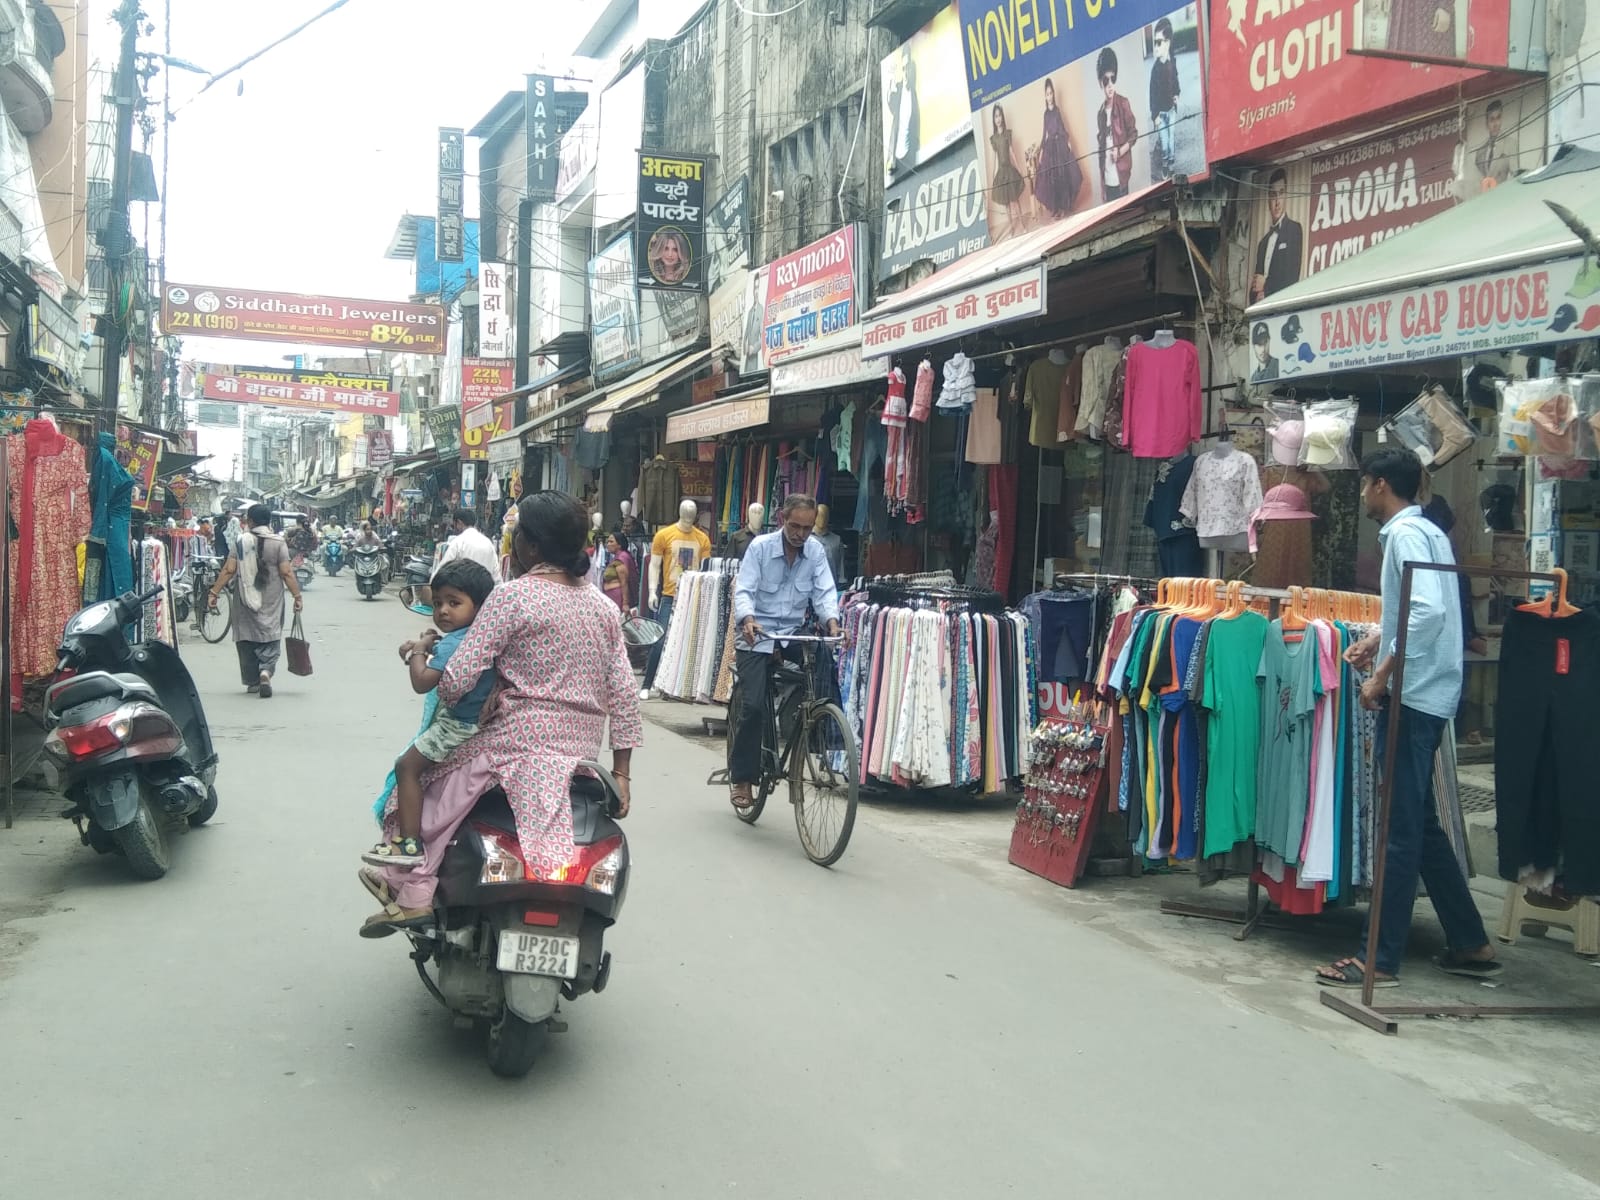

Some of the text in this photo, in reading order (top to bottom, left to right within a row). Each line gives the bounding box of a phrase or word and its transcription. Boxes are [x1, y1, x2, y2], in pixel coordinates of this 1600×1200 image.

[1250, 10, 1343, 92] CLOTH
[1238, 93, 1296, 129] Siyaram's
[533, 80, 547, 180] SAKHI
[641, 157, 703, 180] अल्का
[655, 181, 689, 199] ब्यूटी
[1311, 157, 1458, 232] AROMA TAILO
[642, 199, 700, 222] पार्लर
[882, 159, 987, 260] FASHIO
[776, 236, 845, 288] Raymond
[958, 235, 986, 257] Wear
[225, 295, 437, 325] Siddharth Jewellers
[864, 279, 1039, 346] मलिक वालो की दुकान
[1320, 270, 1550, 353] FANCY CAP HOUSE
[173, 311, 190, 327] 22
[193, 313, 202, 327] K
[205, 314, 238, 330] (916)
[371, 324, 414, 345] 8%
[215, 377, 240, 393] श्री
[300, 386, 328, 402] जी
[518, 935, 570, 957] UP20C
[515, 953, 567, 975] R3224
